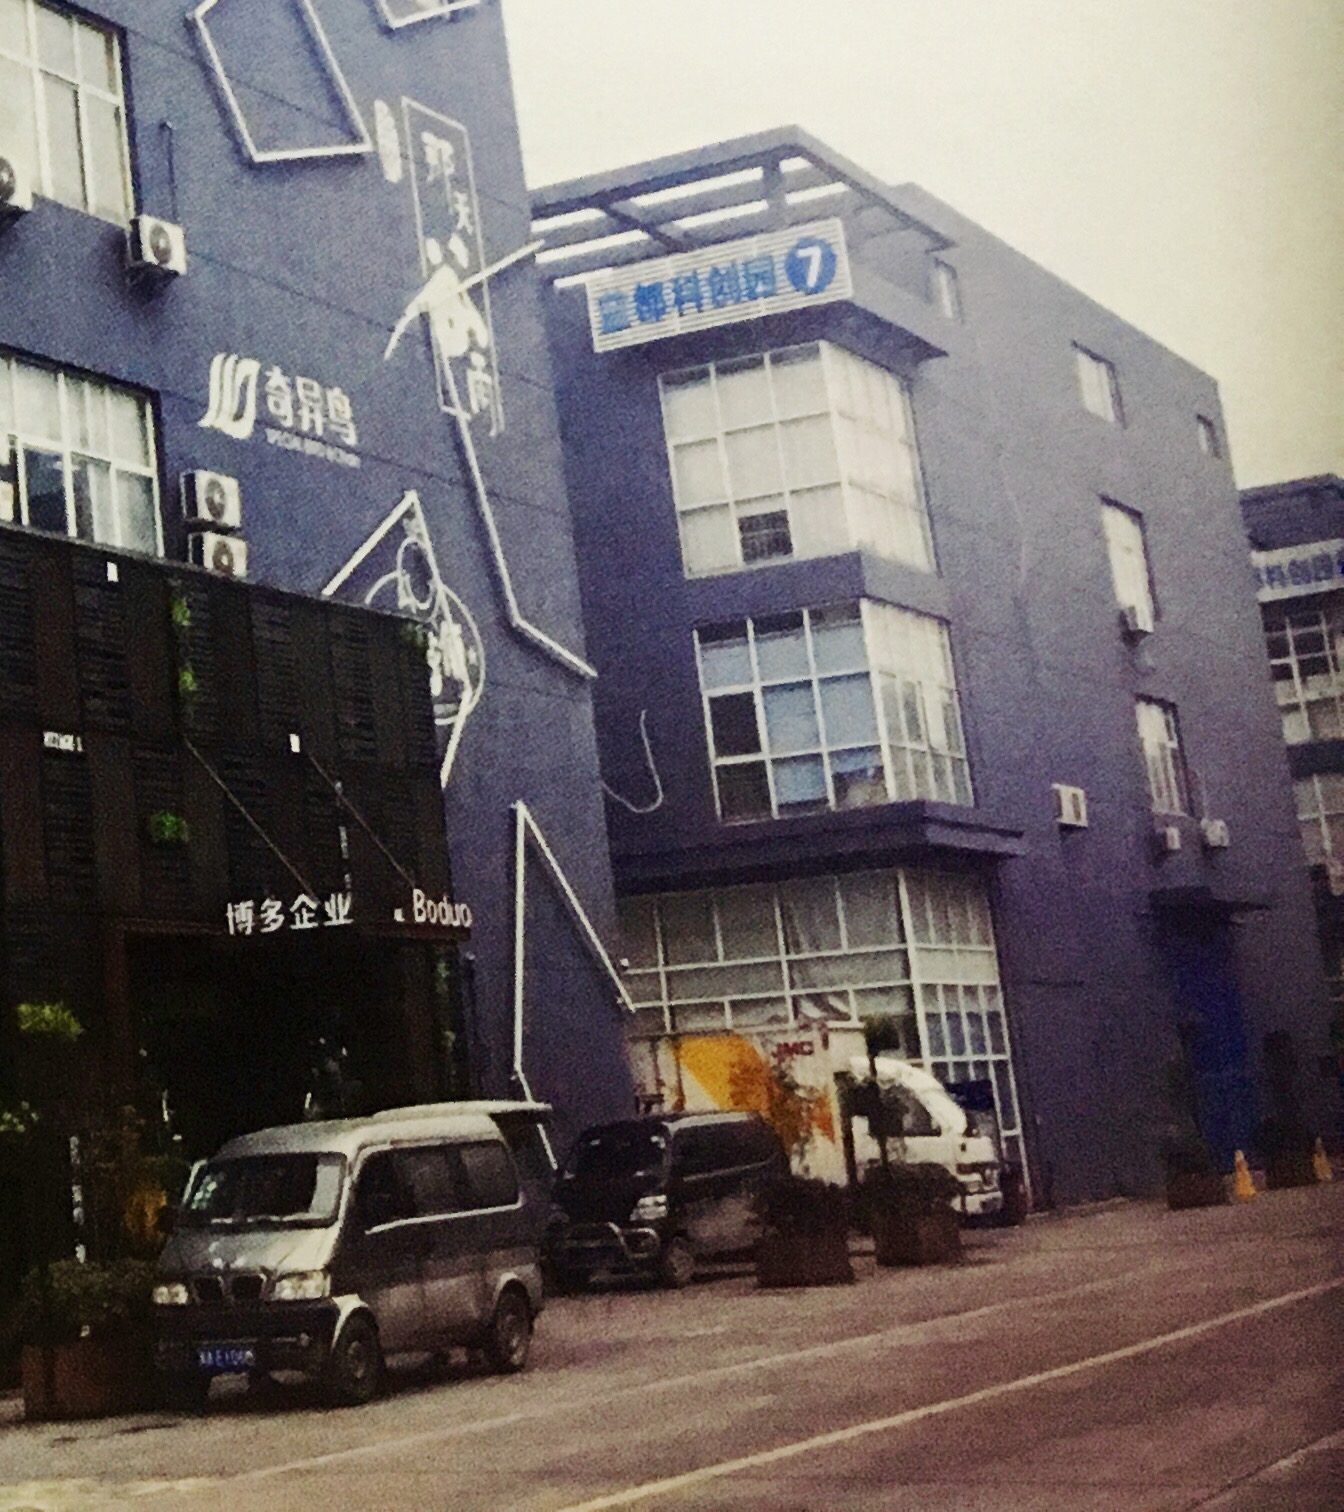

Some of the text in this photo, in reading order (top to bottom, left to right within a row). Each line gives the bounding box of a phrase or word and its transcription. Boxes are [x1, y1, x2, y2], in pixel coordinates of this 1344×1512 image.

[264, 364, 358, 447] 奇异鸟
[225, 891, 354, 936] 博多企业
[412, 888, 473, 927] Boduo
